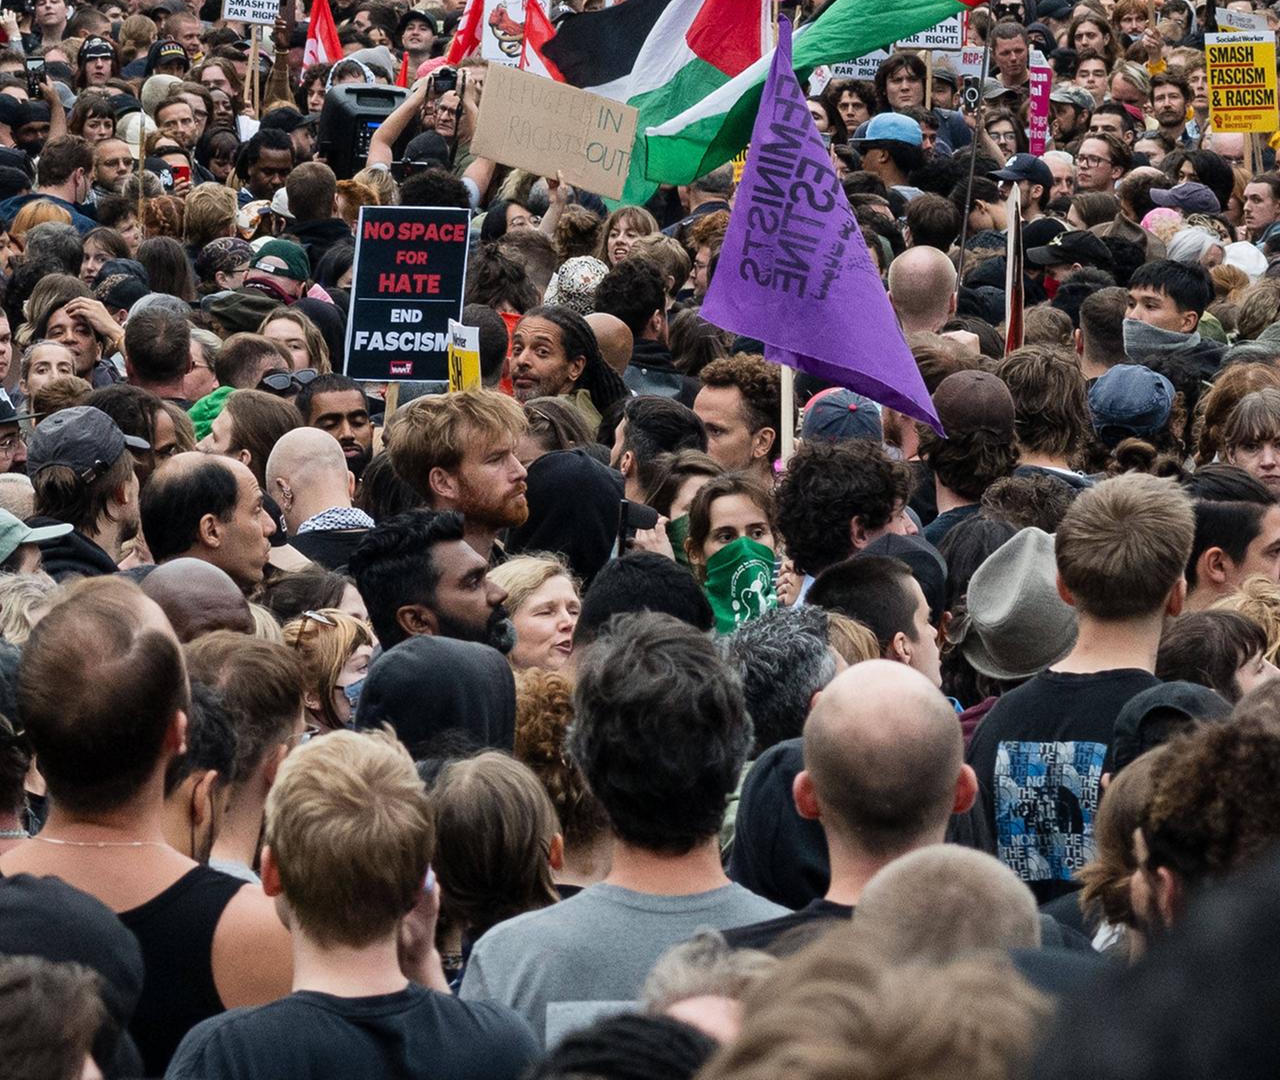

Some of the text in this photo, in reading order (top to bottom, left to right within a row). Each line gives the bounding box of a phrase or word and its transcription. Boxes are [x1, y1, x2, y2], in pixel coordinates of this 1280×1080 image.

[1209, 47, 1254, 63] SMASH
[1210, 67, 1266, 85] FASCISM
[1212, 89, 1274, 107] & RACISM
[597, 106, 624, 134] IN
[586, 141, 627, 176] OUT
[363, 221, 467, 242] NO SPACE
[395, 250, 427, 265] FOR
[378, 273, 441, 293] HATE
[390, 308, 422, 323] END
[354, 331, 450, 353] FASCISM
